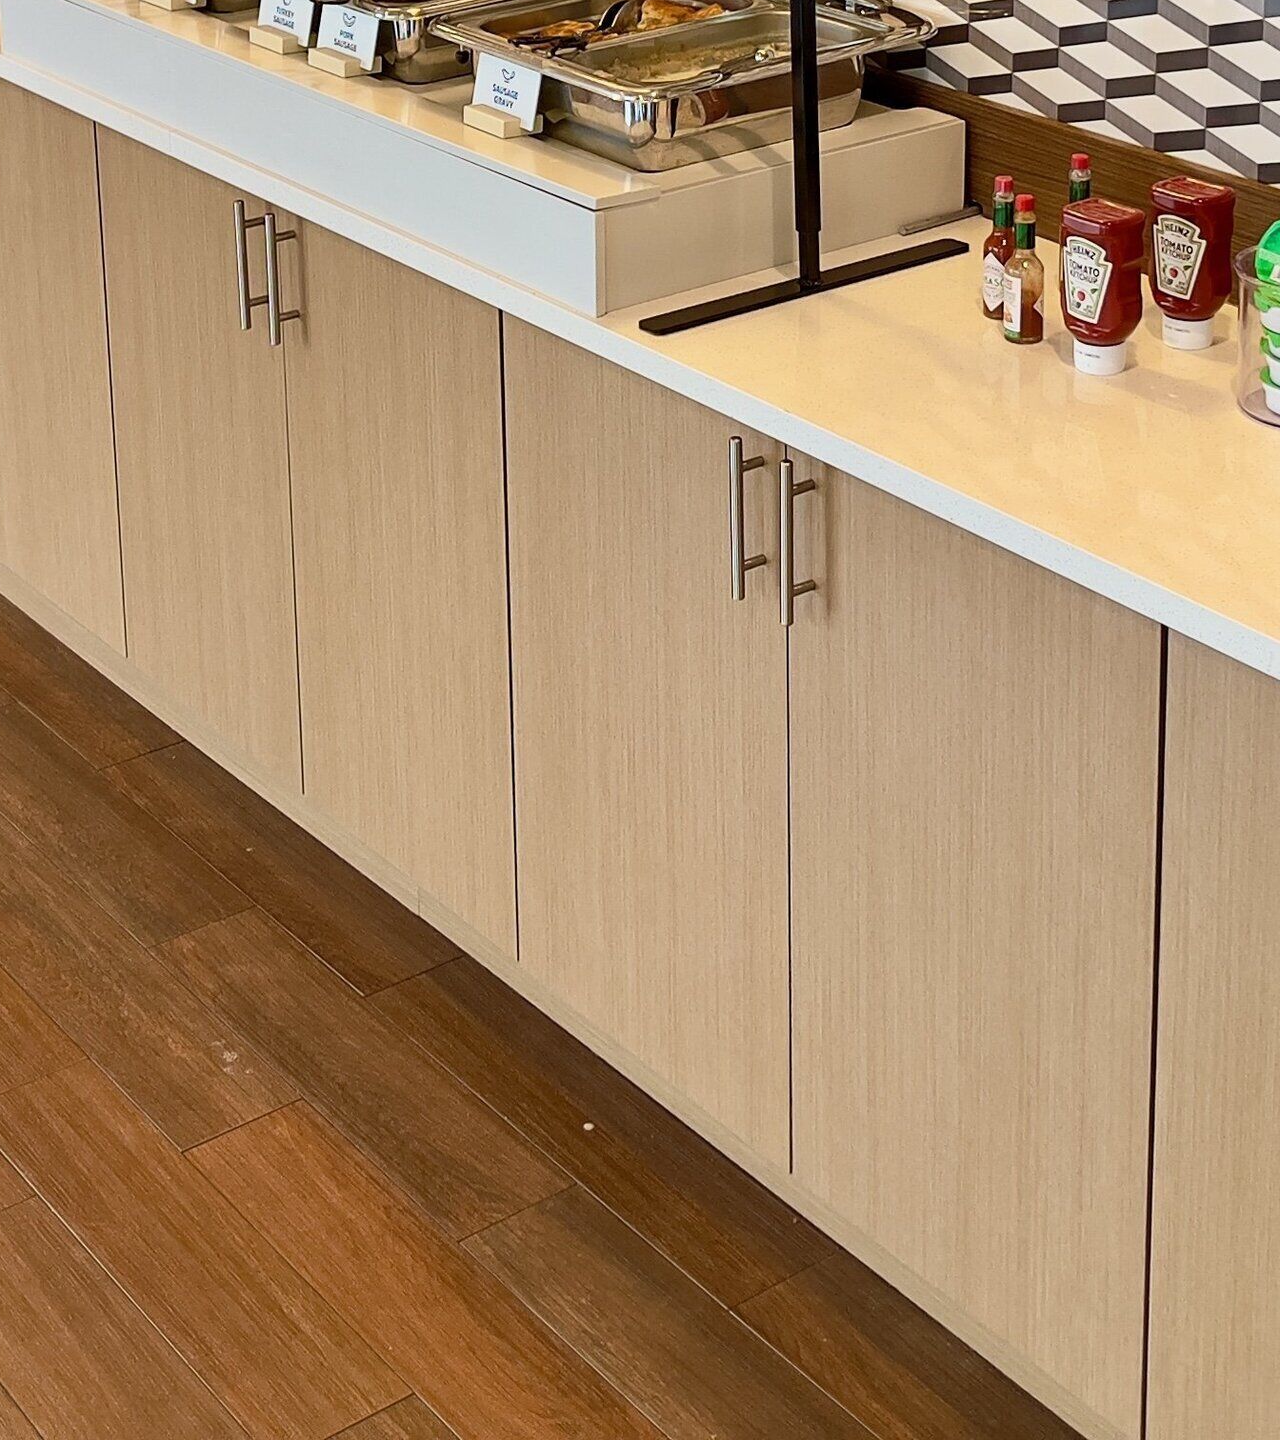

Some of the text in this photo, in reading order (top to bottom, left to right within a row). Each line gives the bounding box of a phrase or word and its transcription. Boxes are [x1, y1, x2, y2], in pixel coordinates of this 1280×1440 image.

[1164, 223, 1190, 238] HEINZ
[1072, 245, 1097, 261] HEINZ
[1160, 236, 1194, 254] TOMATO
[1161, 246, 1191, 261] KETCHUP
[1068, 258, 1100, 278] TOMATO
